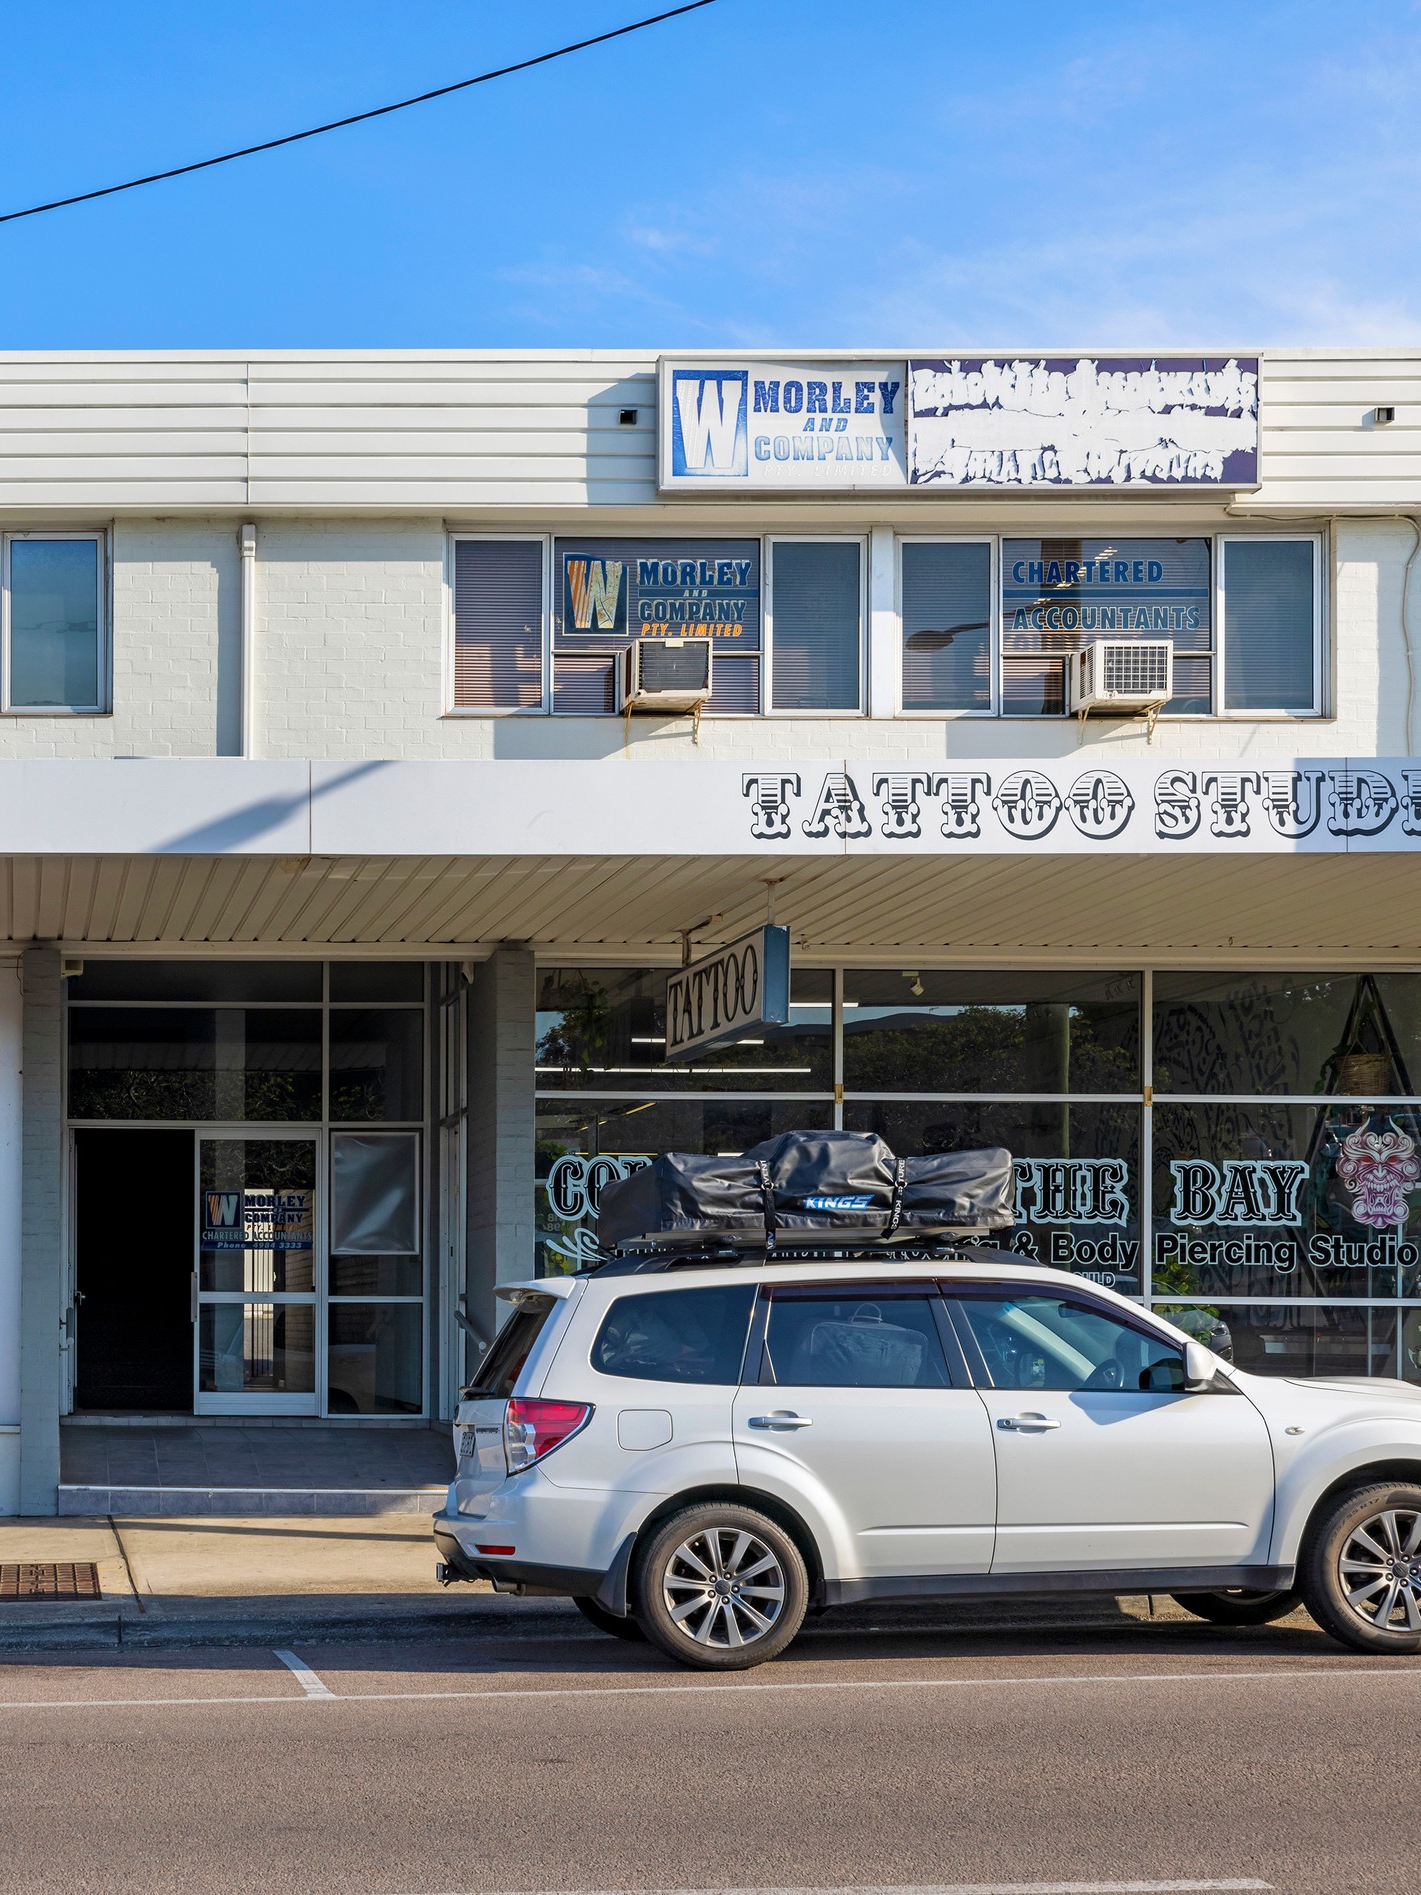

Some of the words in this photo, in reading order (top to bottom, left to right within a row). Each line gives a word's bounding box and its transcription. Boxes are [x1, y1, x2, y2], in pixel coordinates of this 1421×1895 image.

[753, 380, 900, 414] MORLEY
[802, 417, 848, 432] AND
[754, 435, 893, 462] COMPANY
[814, 464, 893, 477] LIMITED
[636, 559, 752, 587] MORLEY
[1012, 560, 1163, 585] CHARTERED
[683, 588, 708, 598] AND
[638, 600, 747, 623] COMPANY
[1012, 605, 1201, 631] ACCOUNTANTS
[640, 623, 673, 637] PTY.
[681, 623, 743, 637] LIMITED
[741, 769, 1134, 840] TATTOO
[668, 944, 758, 1047] TATTOO
[244, 1194, 306, 1207] MORLEY
[805, 1194, 873, 1210] KINGS
[1012, 1158, 1130, 1227] THE
[1170, 1159, 1310, 1227] BAY
[244, 1212, 303, 1223] COMPANY
[202, 1231, 249, 1240] CHARTERED
[252, 1231, 312, 1241] ACCOUNTANTS
[1050, 1231, 1140, 1271] Body
[1155, 1232, 1297, 1274] Piercing
[1308, 1233, 1419, 1267] Studio
